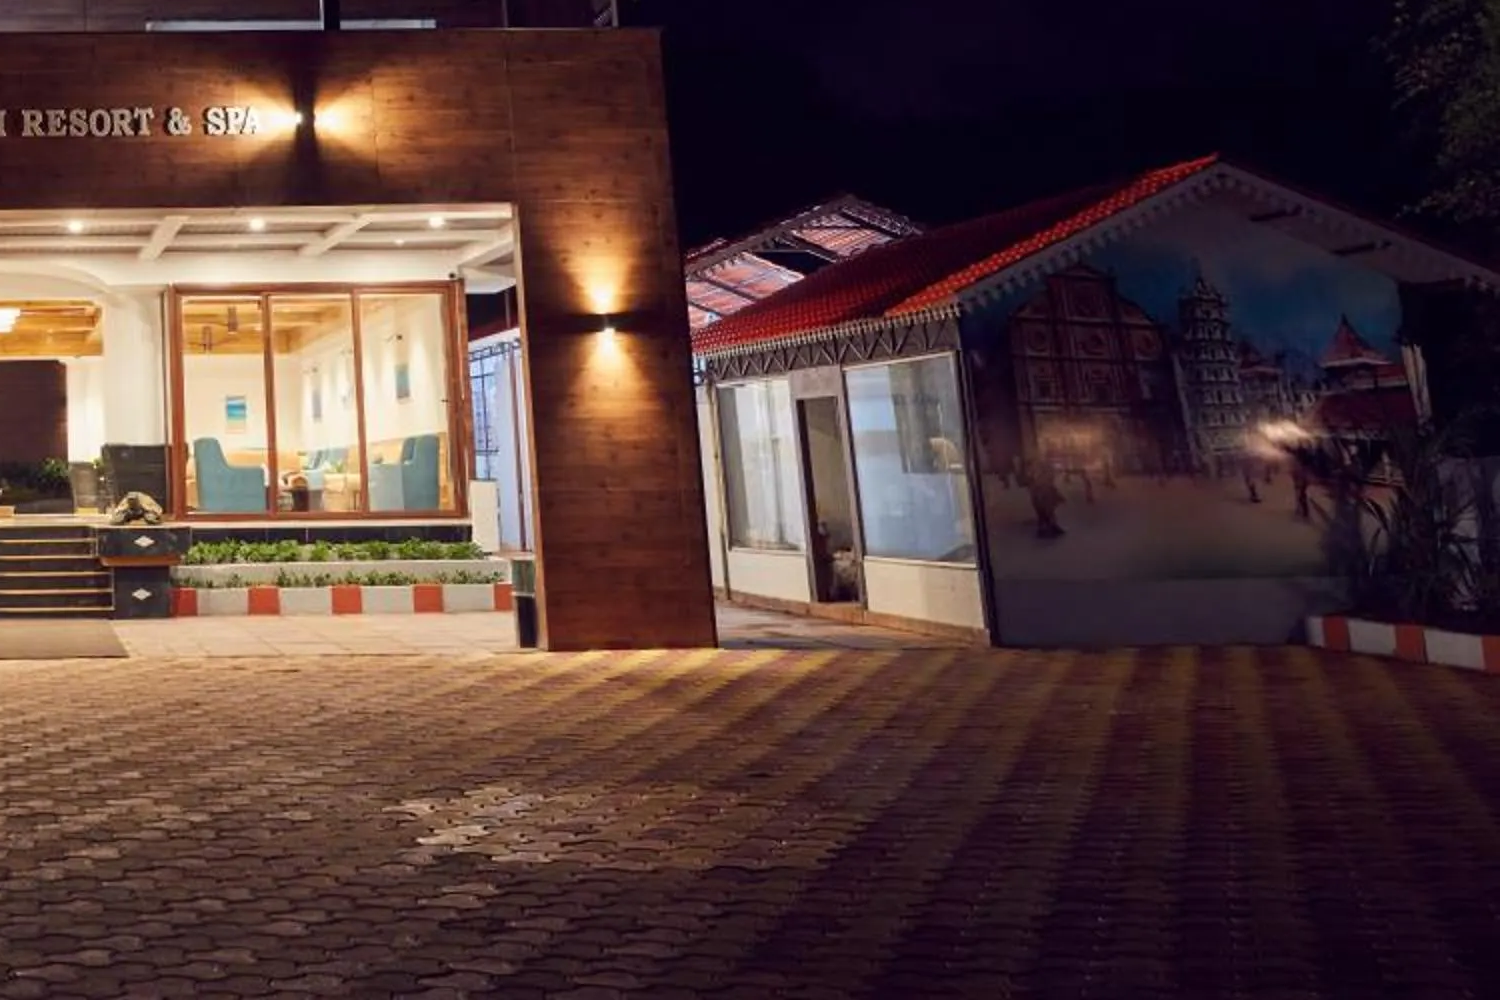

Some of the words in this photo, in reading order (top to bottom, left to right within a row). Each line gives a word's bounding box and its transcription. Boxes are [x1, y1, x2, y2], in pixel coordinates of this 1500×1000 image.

[21, 108, 154, 137] RESORT
[167, 106, 192, 136] &
[205, 106, 260, 136] SPA
